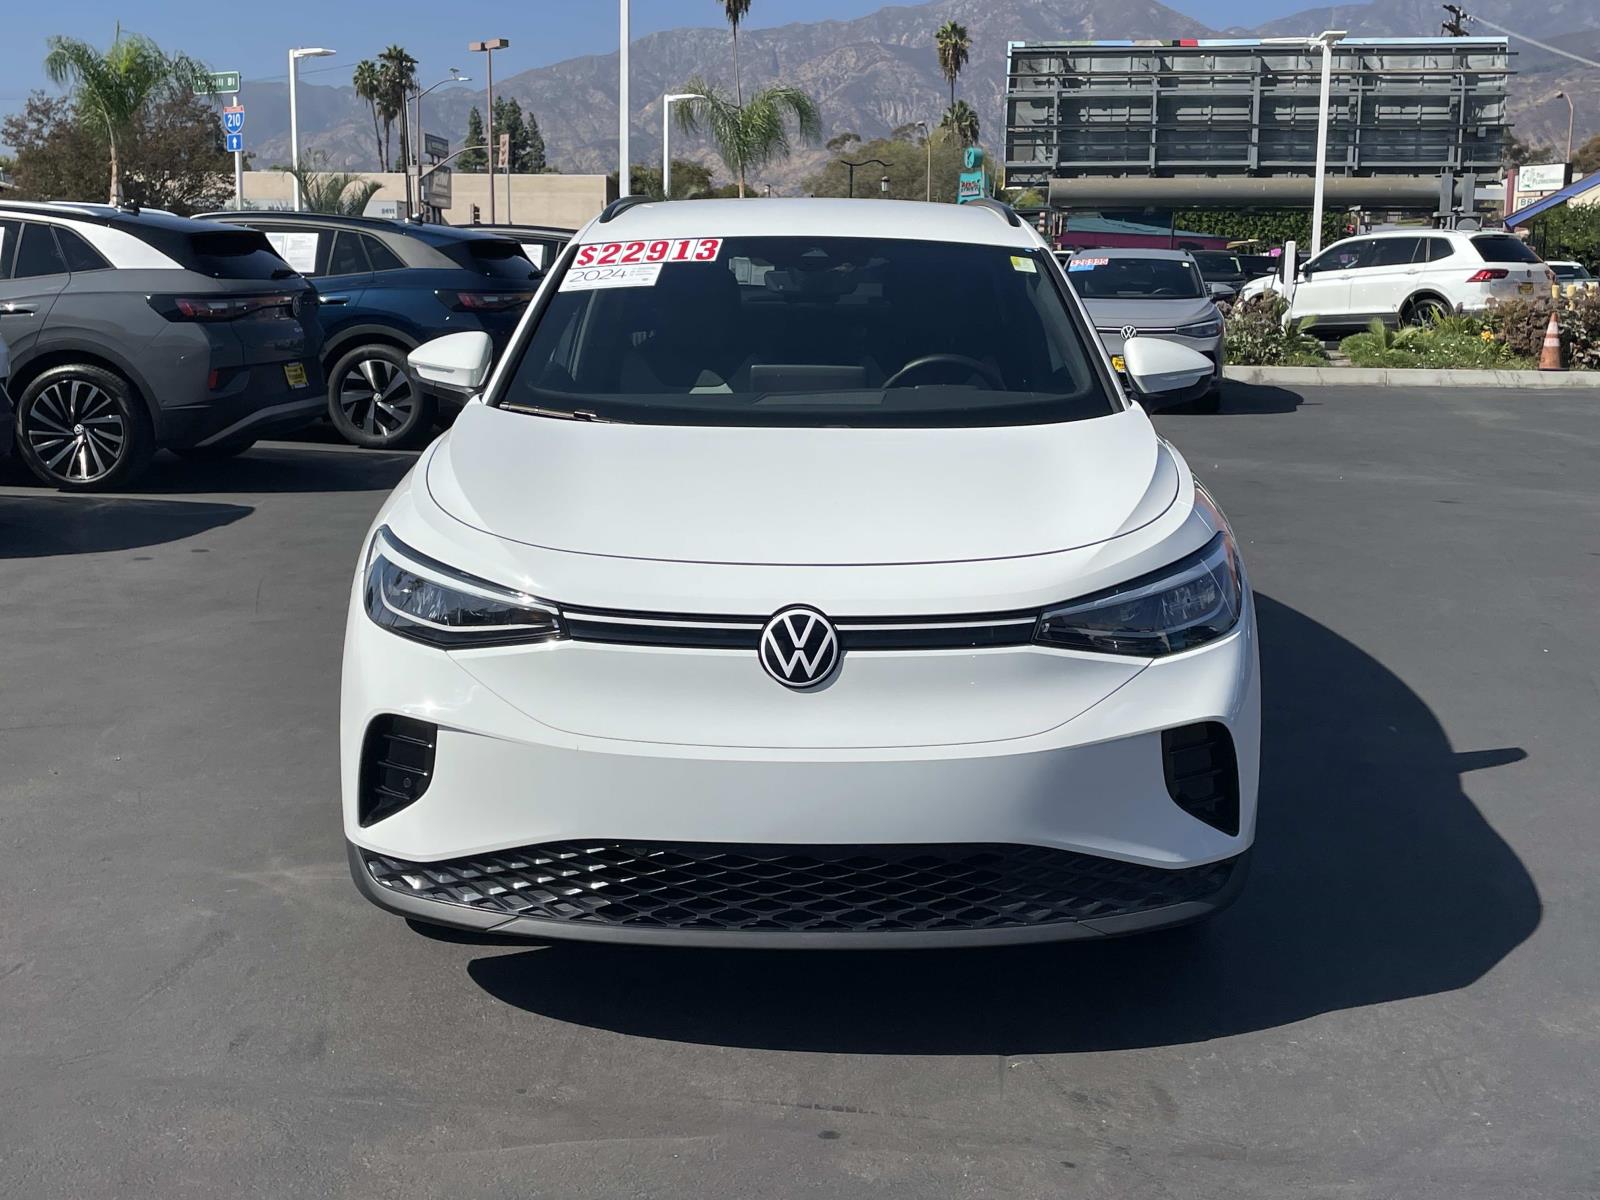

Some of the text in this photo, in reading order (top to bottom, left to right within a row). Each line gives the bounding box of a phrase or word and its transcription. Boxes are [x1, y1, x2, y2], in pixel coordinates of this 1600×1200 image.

[227, 113, 241, 127] 210
[577, 239, 719, 266] $22913
[569, 268, 627, 283] 2024
[762, 609, 837, 686] VW
